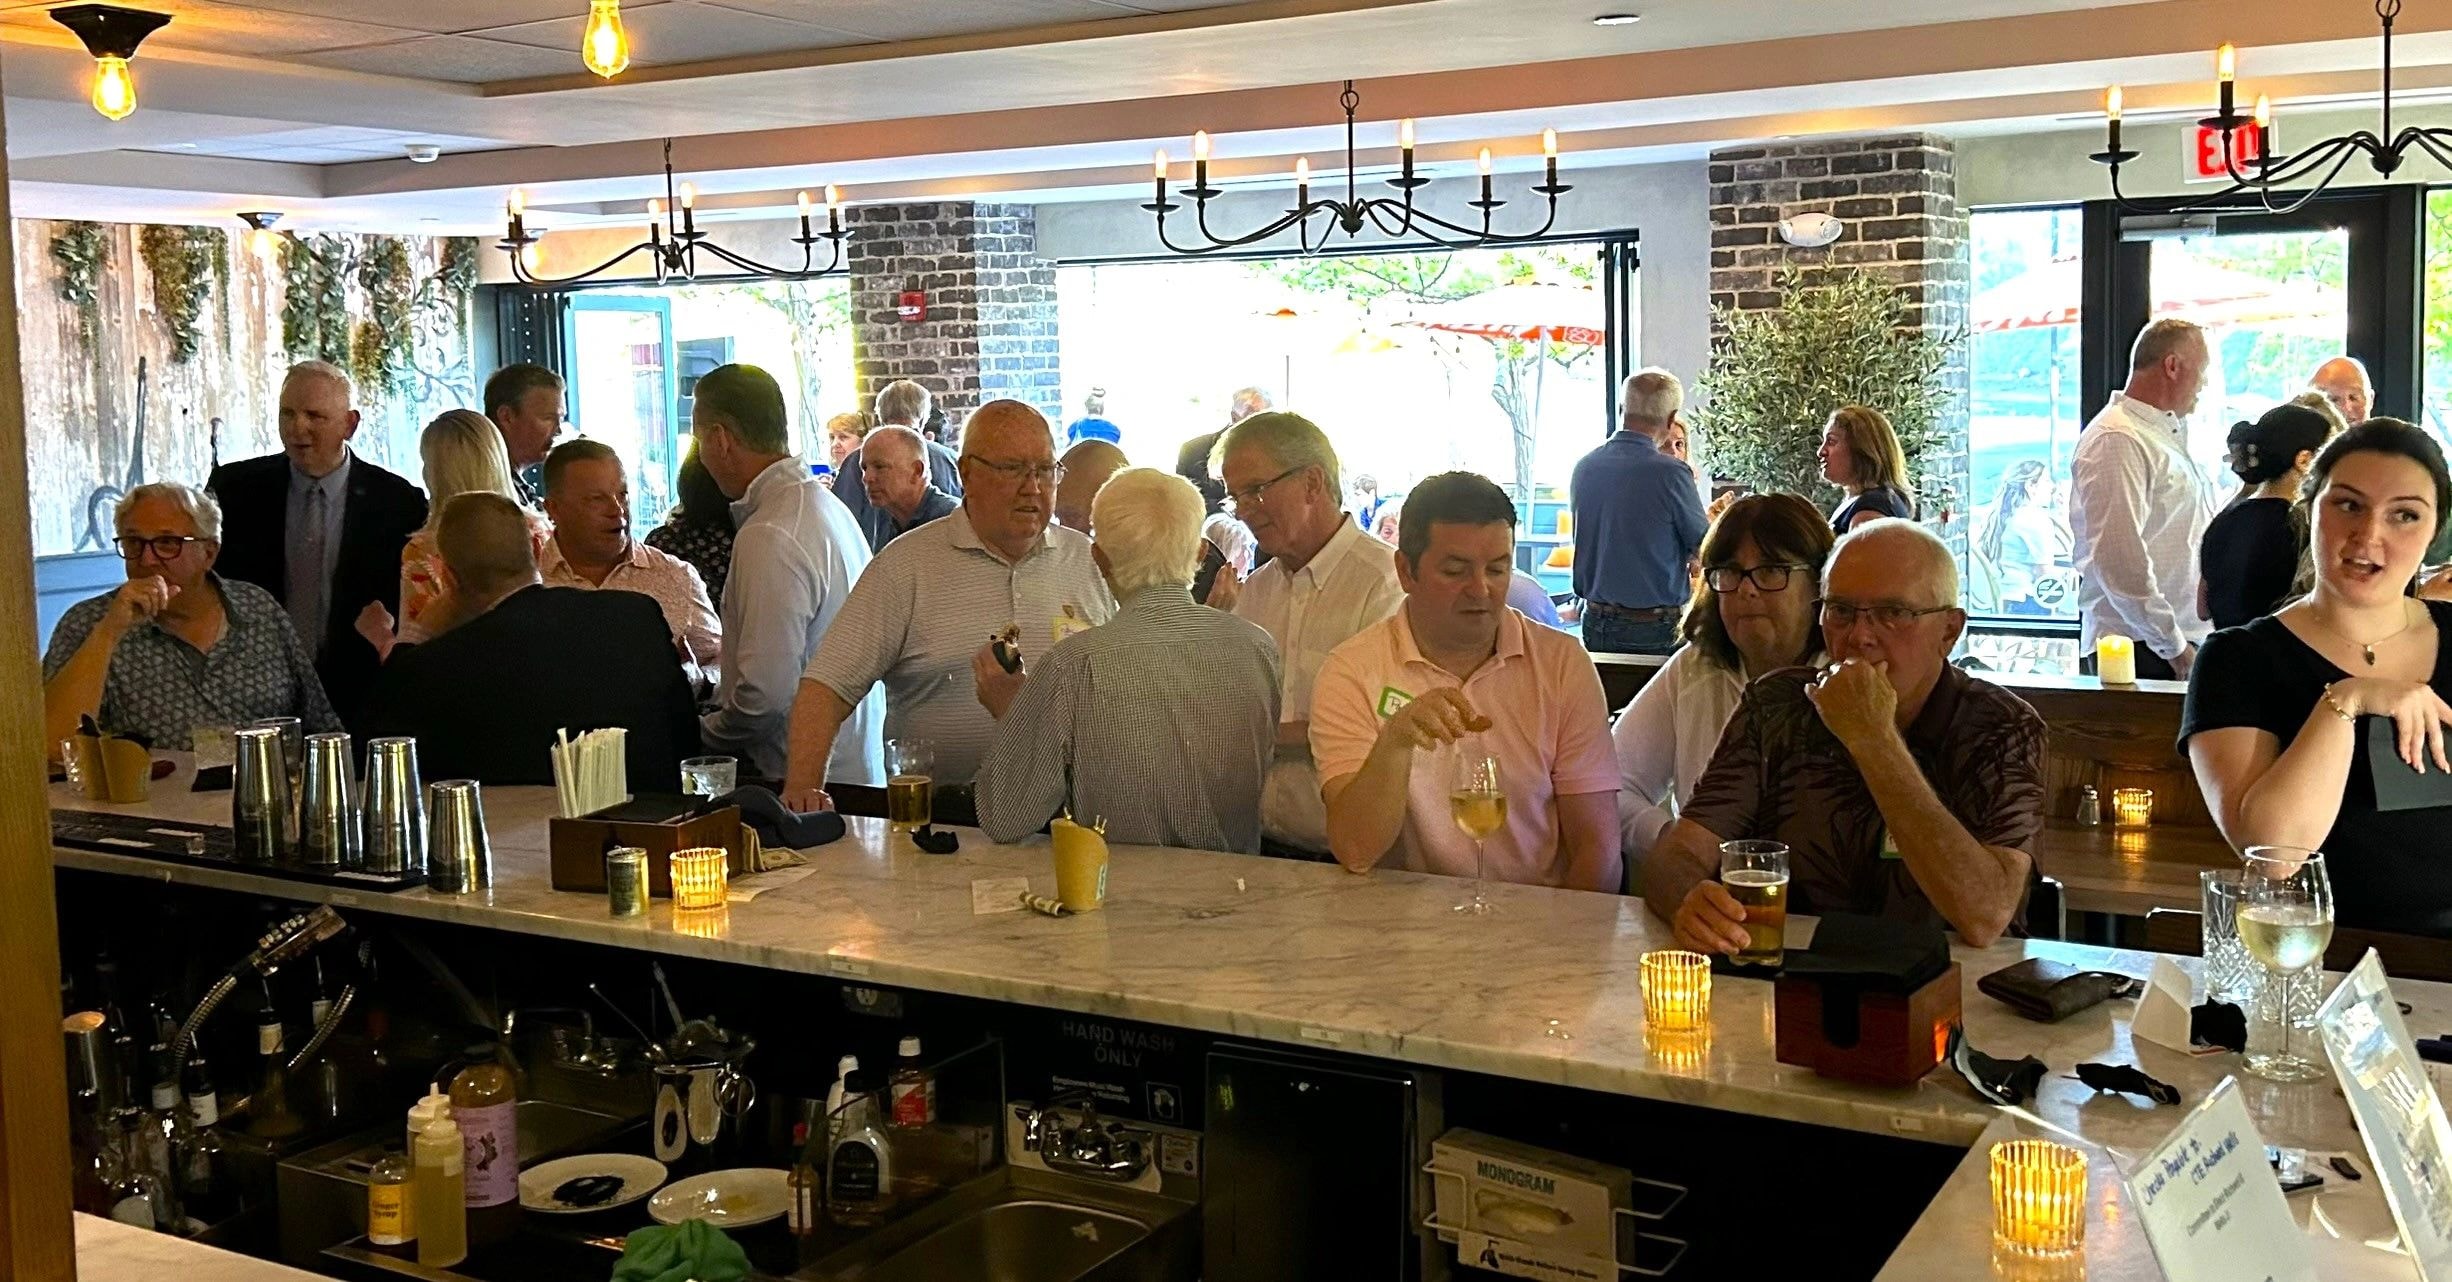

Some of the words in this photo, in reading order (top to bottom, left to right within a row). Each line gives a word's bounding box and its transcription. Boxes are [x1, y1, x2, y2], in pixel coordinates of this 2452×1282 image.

[1062, 1021, 1115, 1043] HAND
[1119, 1028, 1176, 1051] WASH
[1094, 1046, 1143, 1068] ONLY
[1476, 1160, 1556, 1195] MONOGRAM
